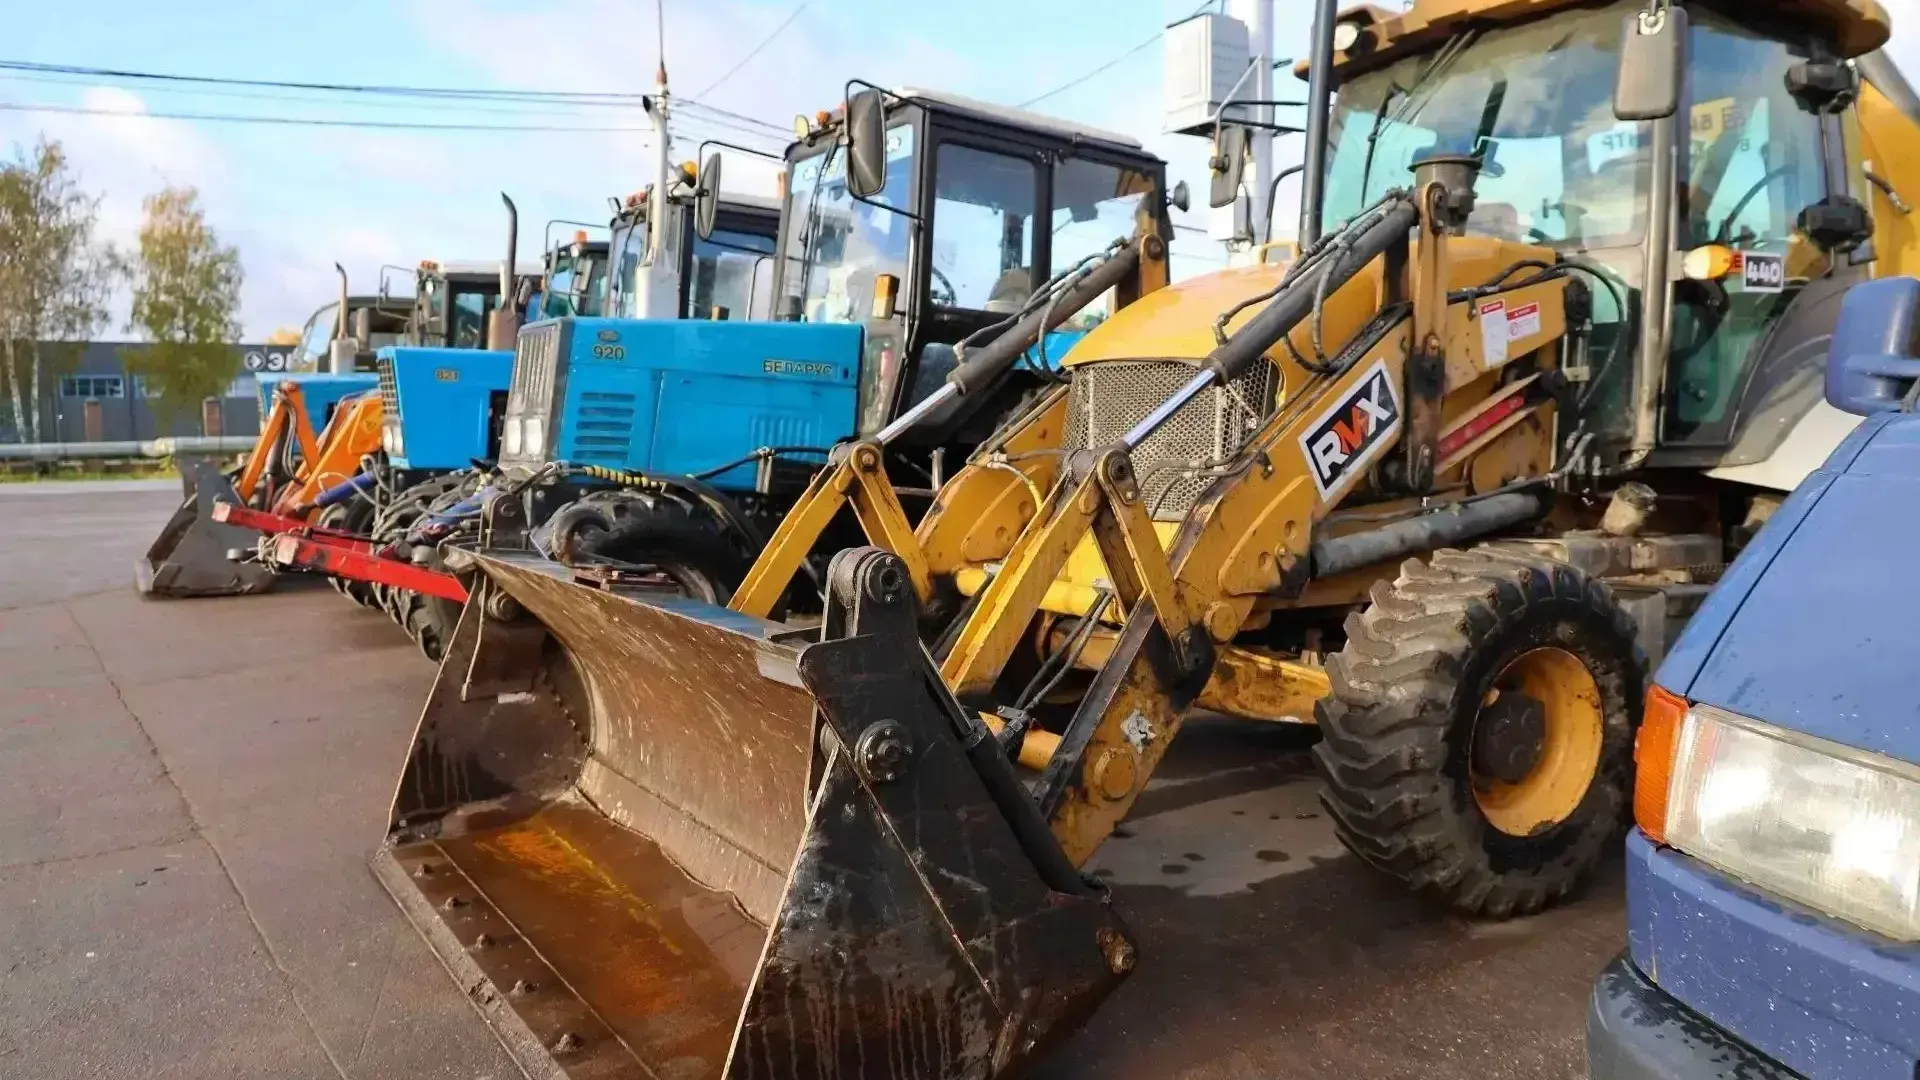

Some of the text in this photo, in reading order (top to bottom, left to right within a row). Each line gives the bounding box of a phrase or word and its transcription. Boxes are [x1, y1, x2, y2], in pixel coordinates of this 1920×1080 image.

[1747, 260, 1781, 283] 440
[593, 345, 624, 360] 920
[1311, 374, 1392, 480] RMX
